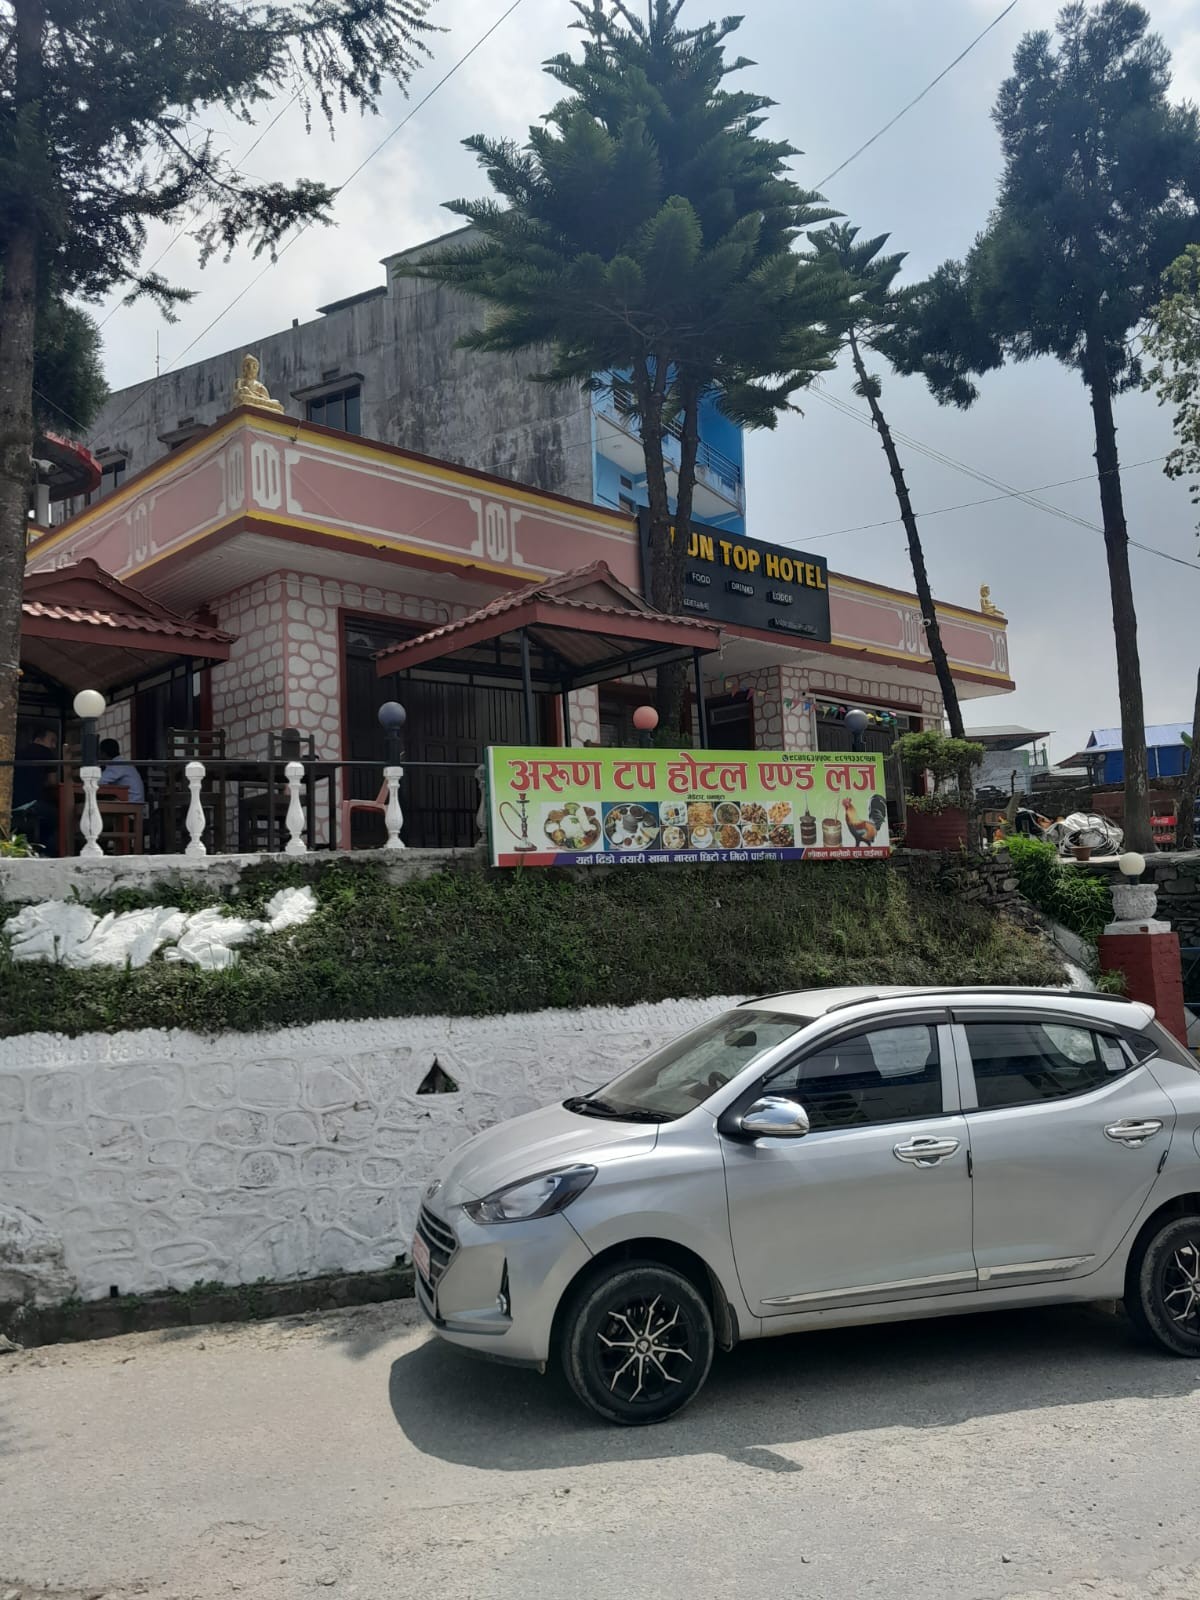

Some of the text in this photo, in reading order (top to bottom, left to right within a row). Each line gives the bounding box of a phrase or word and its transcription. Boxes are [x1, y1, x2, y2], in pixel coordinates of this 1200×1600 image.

[719, 540, 760, 573] TOP
[766, 553, 827, 590] HOTEL
[692, 573, 711, 585] FOOD
[731, 582, 754, 595] DRINKS
[772, 591, 793, 604] LODGE
[508, 752, 876, 793] अरूण टप होटल एण्ड लज
[721, 853, 728, 861] र
